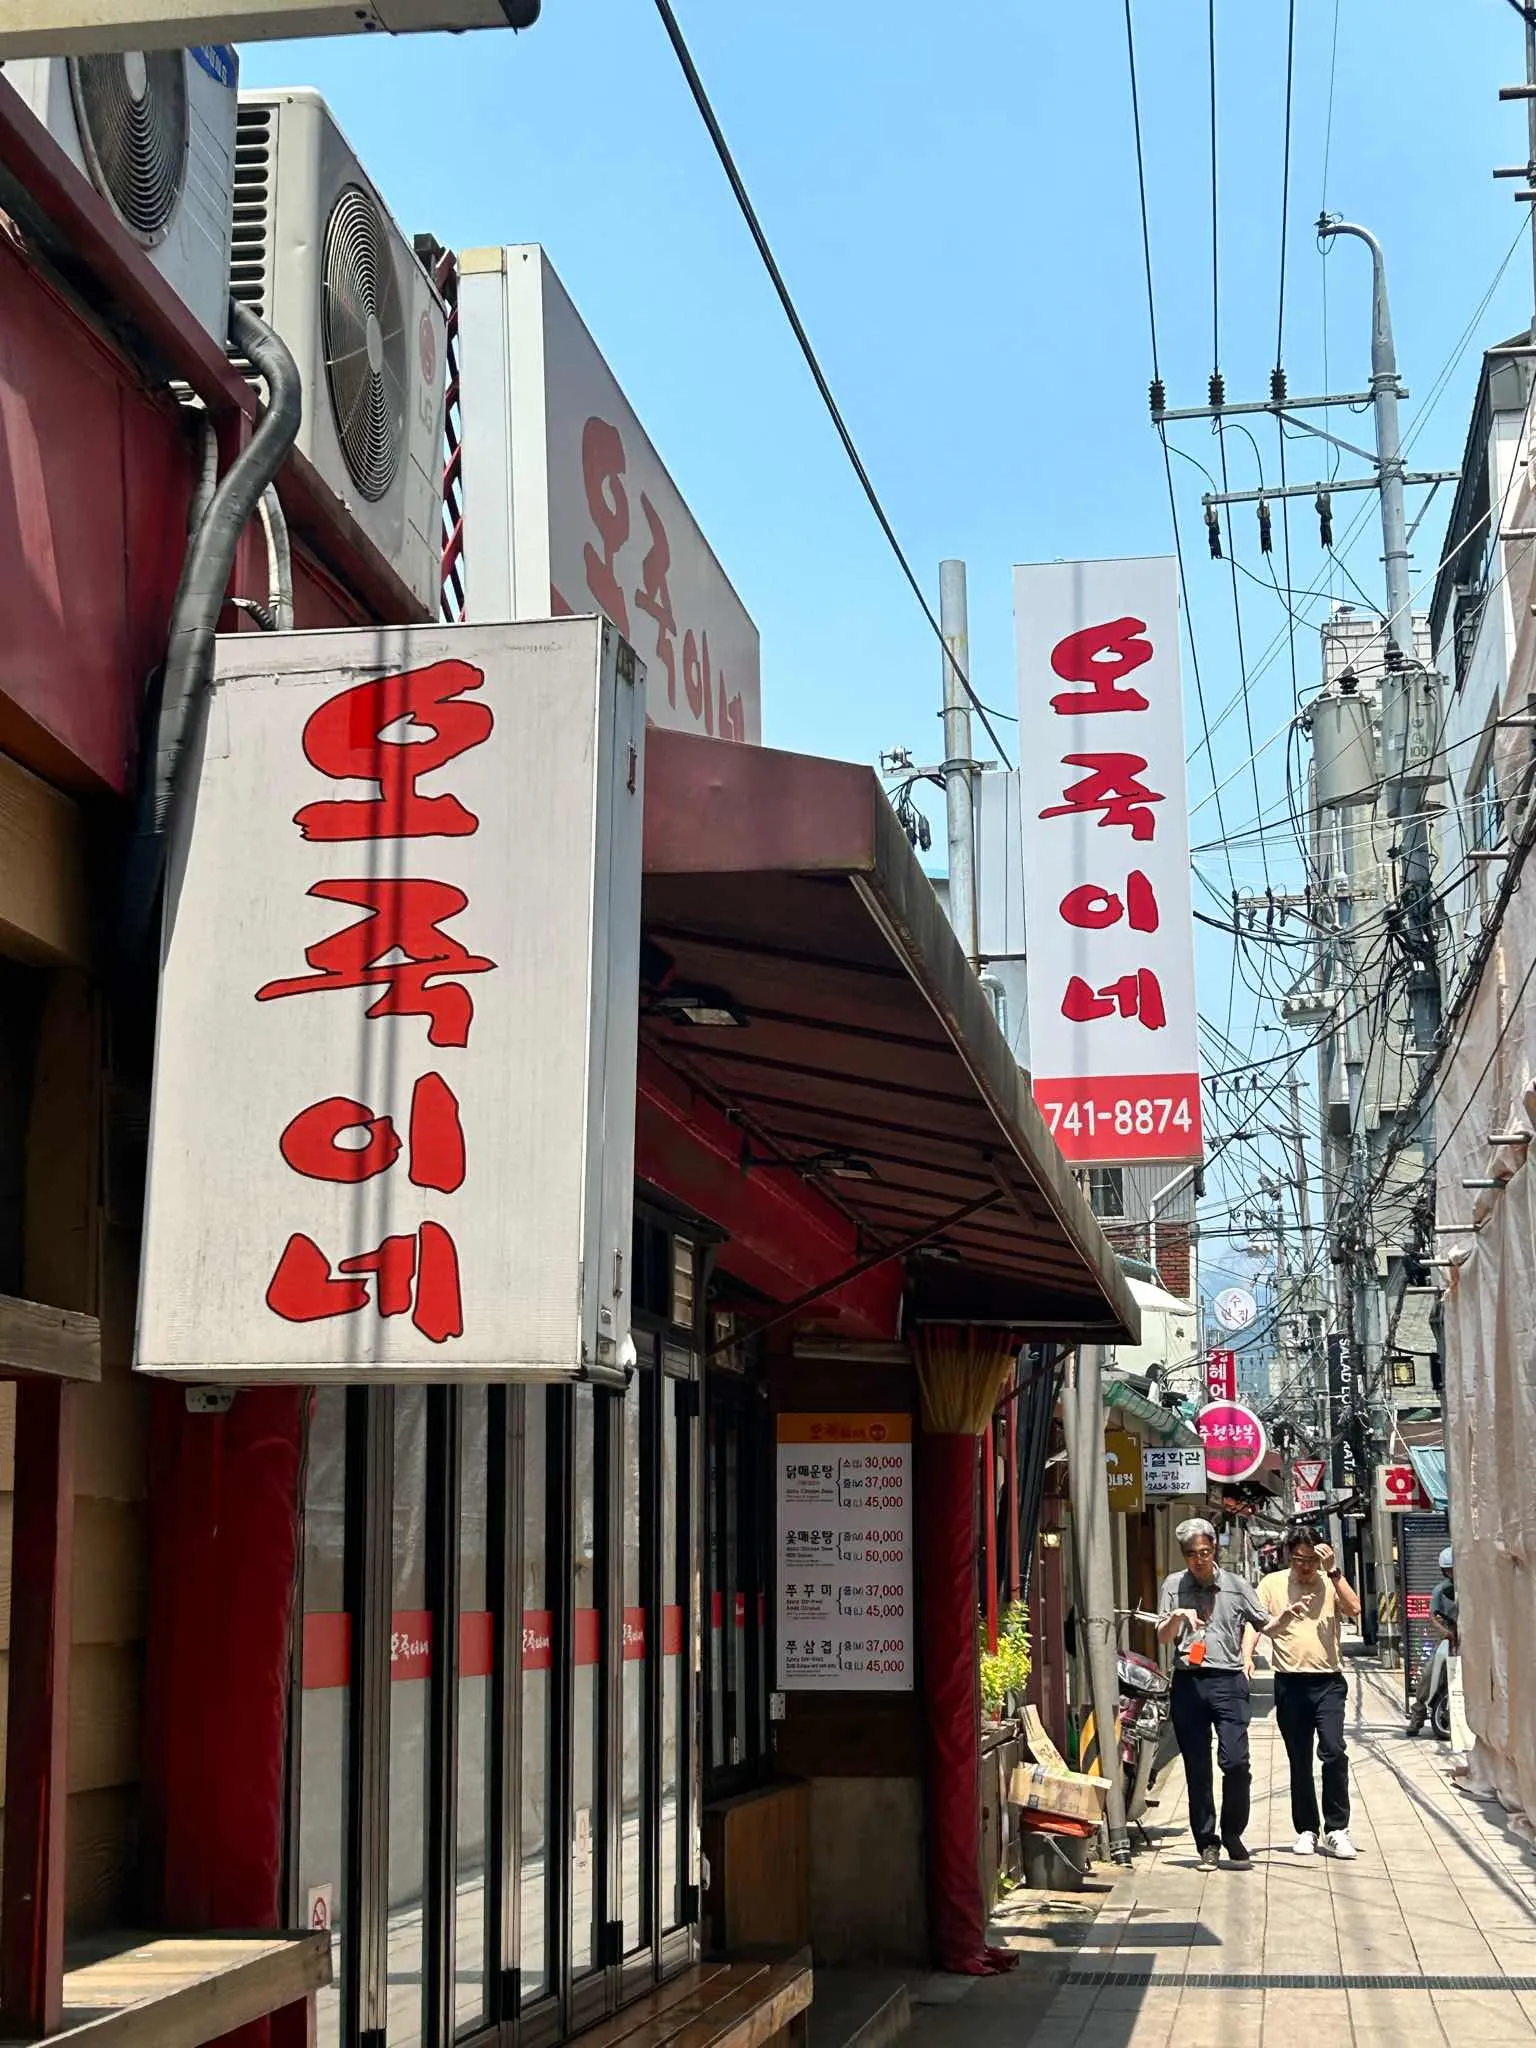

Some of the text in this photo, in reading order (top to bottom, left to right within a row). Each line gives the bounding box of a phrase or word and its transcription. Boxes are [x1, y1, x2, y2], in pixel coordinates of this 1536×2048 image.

[1038, 616, 1167, 1031] 오죽이네
[254, 658, 498, 1343] 오죽이네
[1045, 1098, 1193, 1138] 741-8874
[864, 1456, 903, 1470] 30,000
[864, 1476, 903, 1490] 37,000
[1108, 1473, 1134, 1487] 네컷
[864, 1496, 904, 1510] 45,000
[865, 1530, 904, 1544] 40,000
[865, 1550, 904, 1564] 50,000
[865, 1584, 904, 1599] 37,000
[866, 1604, 904, 1618] 45,000
[866, 1639, 904, 1654] 37,000
[866, 1660, 905, 1674] 45,000
